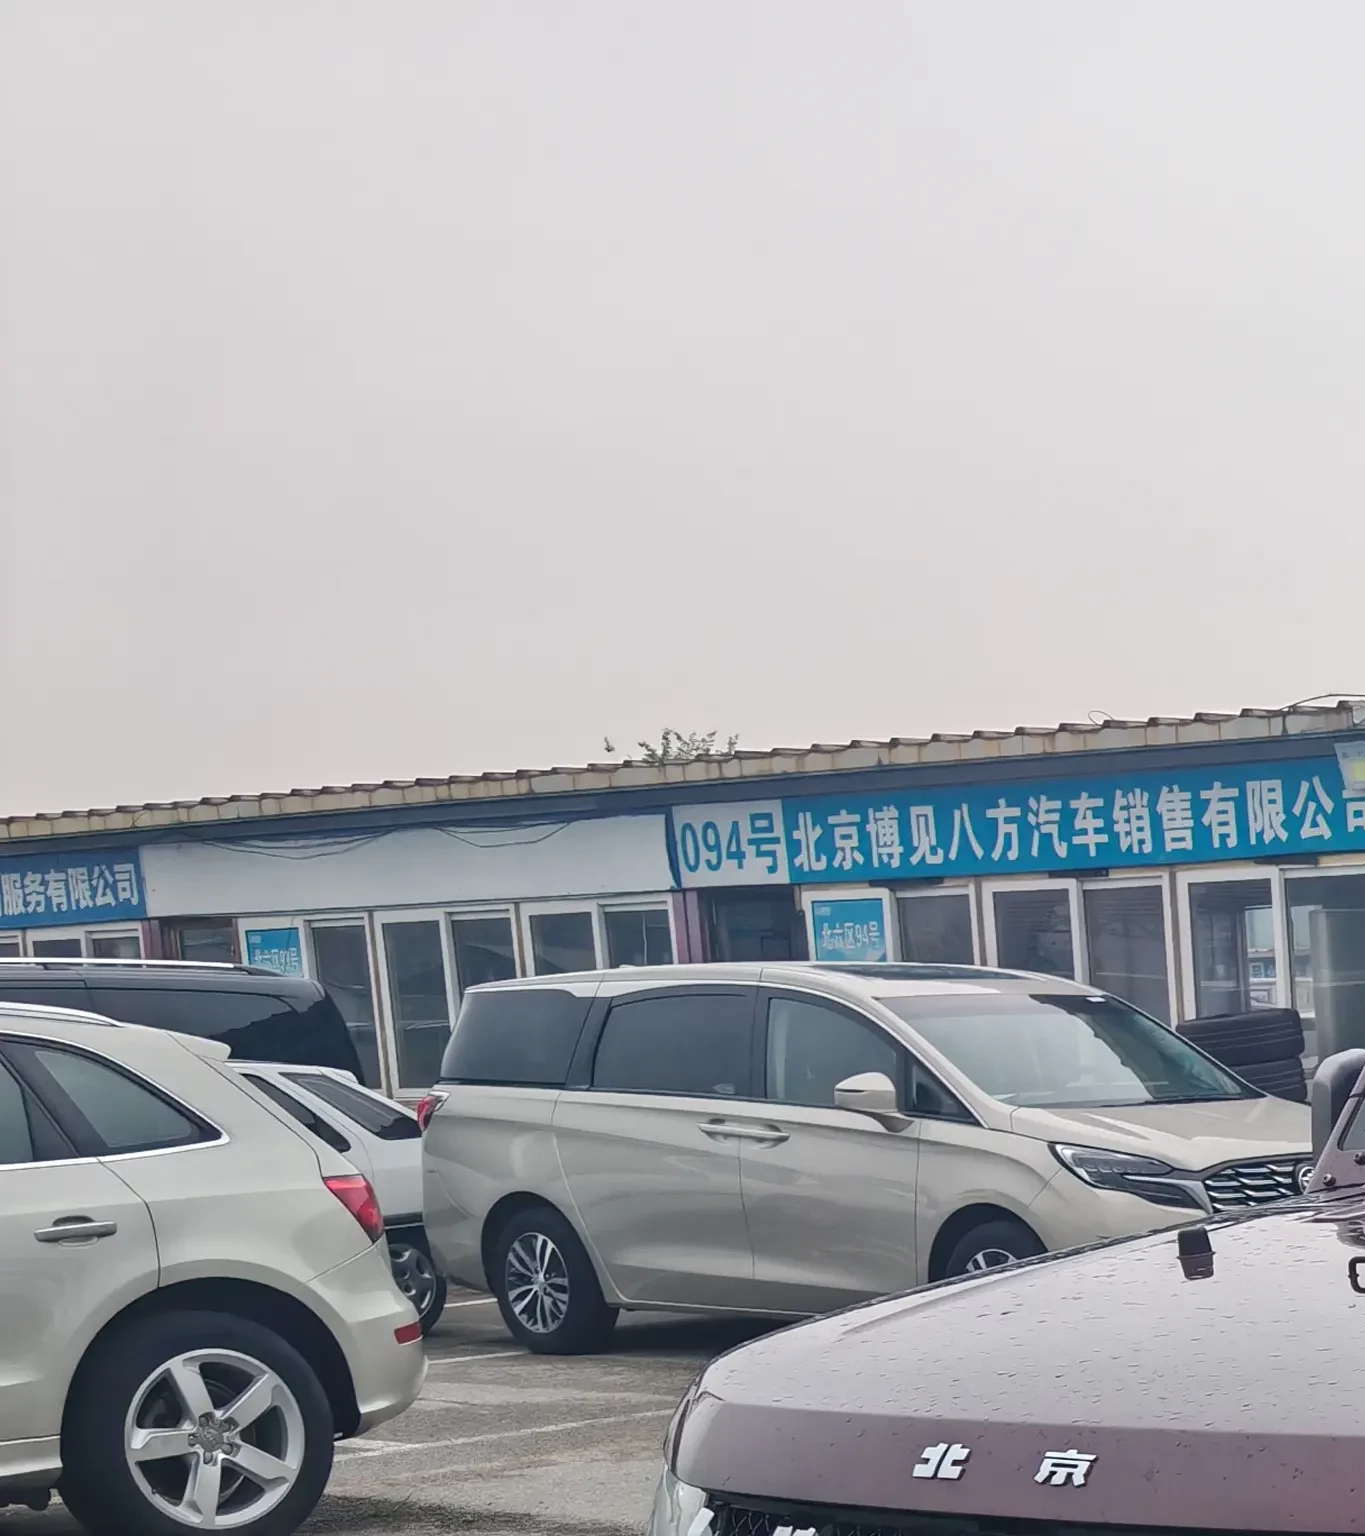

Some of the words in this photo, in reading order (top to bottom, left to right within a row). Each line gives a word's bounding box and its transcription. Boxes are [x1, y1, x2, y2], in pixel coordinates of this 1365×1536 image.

[680, 812, 779, 875] 094号
[1, 863, 138, 915] 服务有限公司
[912, 1443, 1096, 1486] 北京
